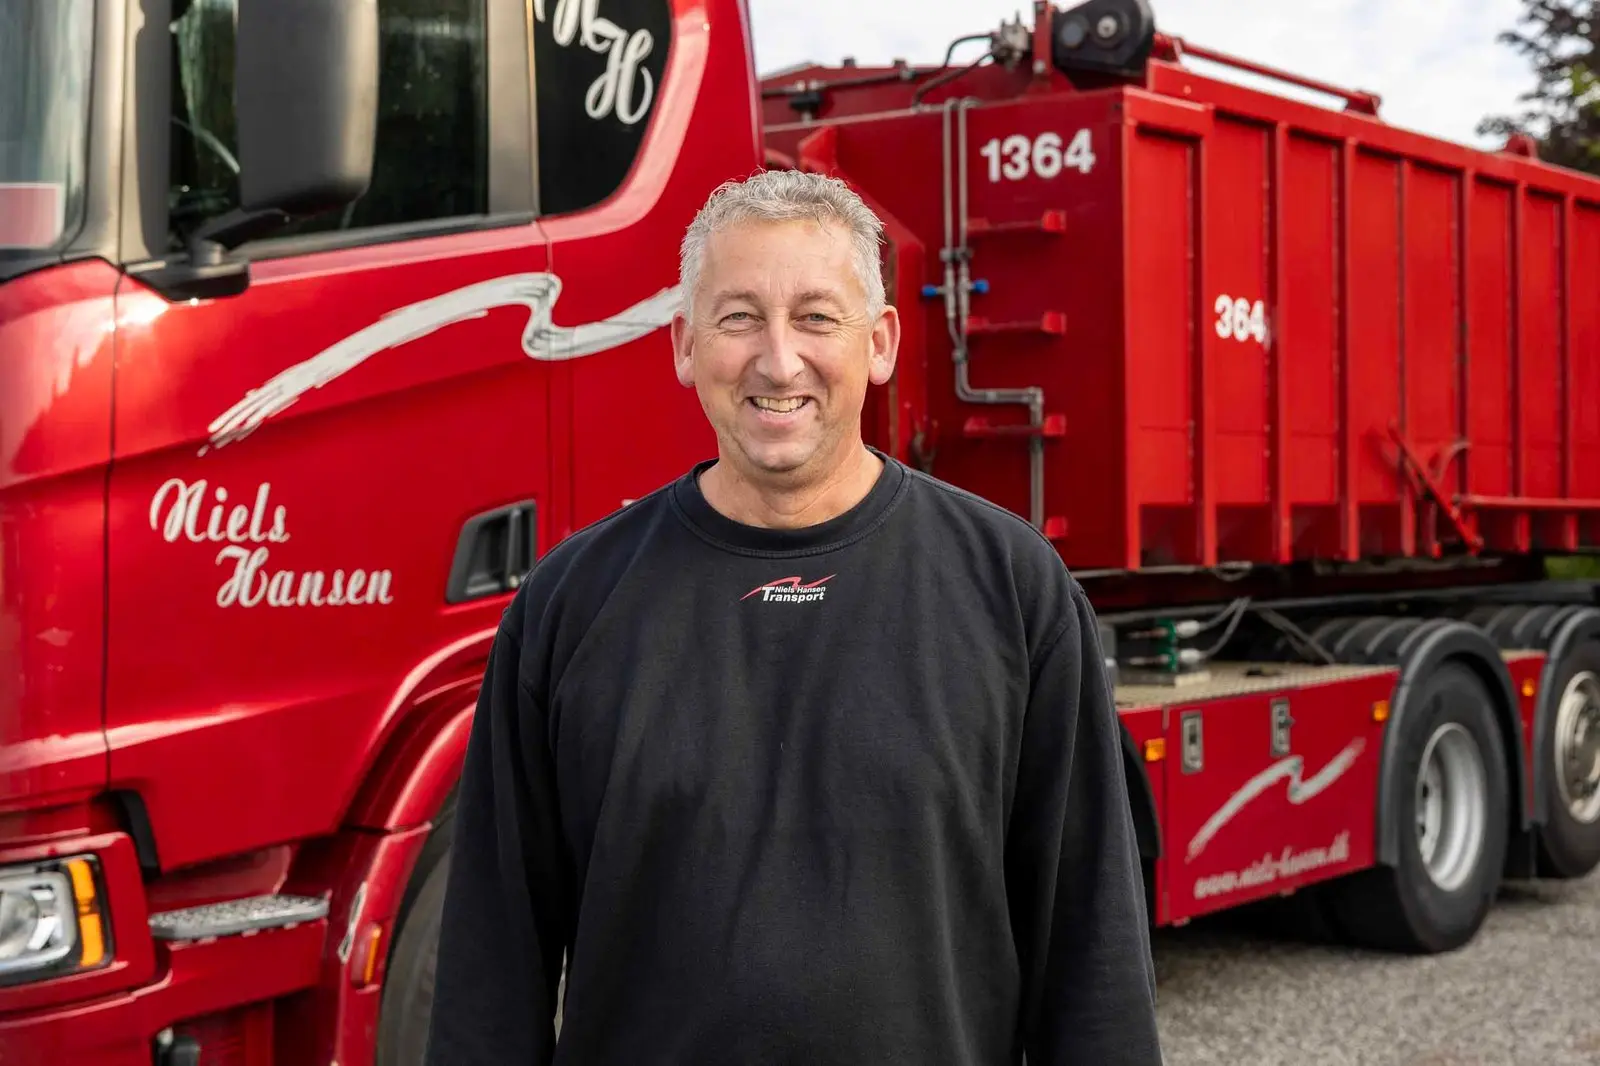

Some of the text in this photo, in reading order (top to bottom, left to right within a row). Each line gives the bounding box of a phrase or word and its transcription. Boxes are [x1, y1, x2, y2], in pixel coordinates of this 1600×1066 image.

[979, 128, 1097, 182] 1364
[1214, 293, 1268, 344] 364
[149, 478, 291, 543] Niels
[214, 545, 394, 608] Hansen
[762, 586, 825, 603] Transport
[774, 586, 826, 594] Niels Hansen
